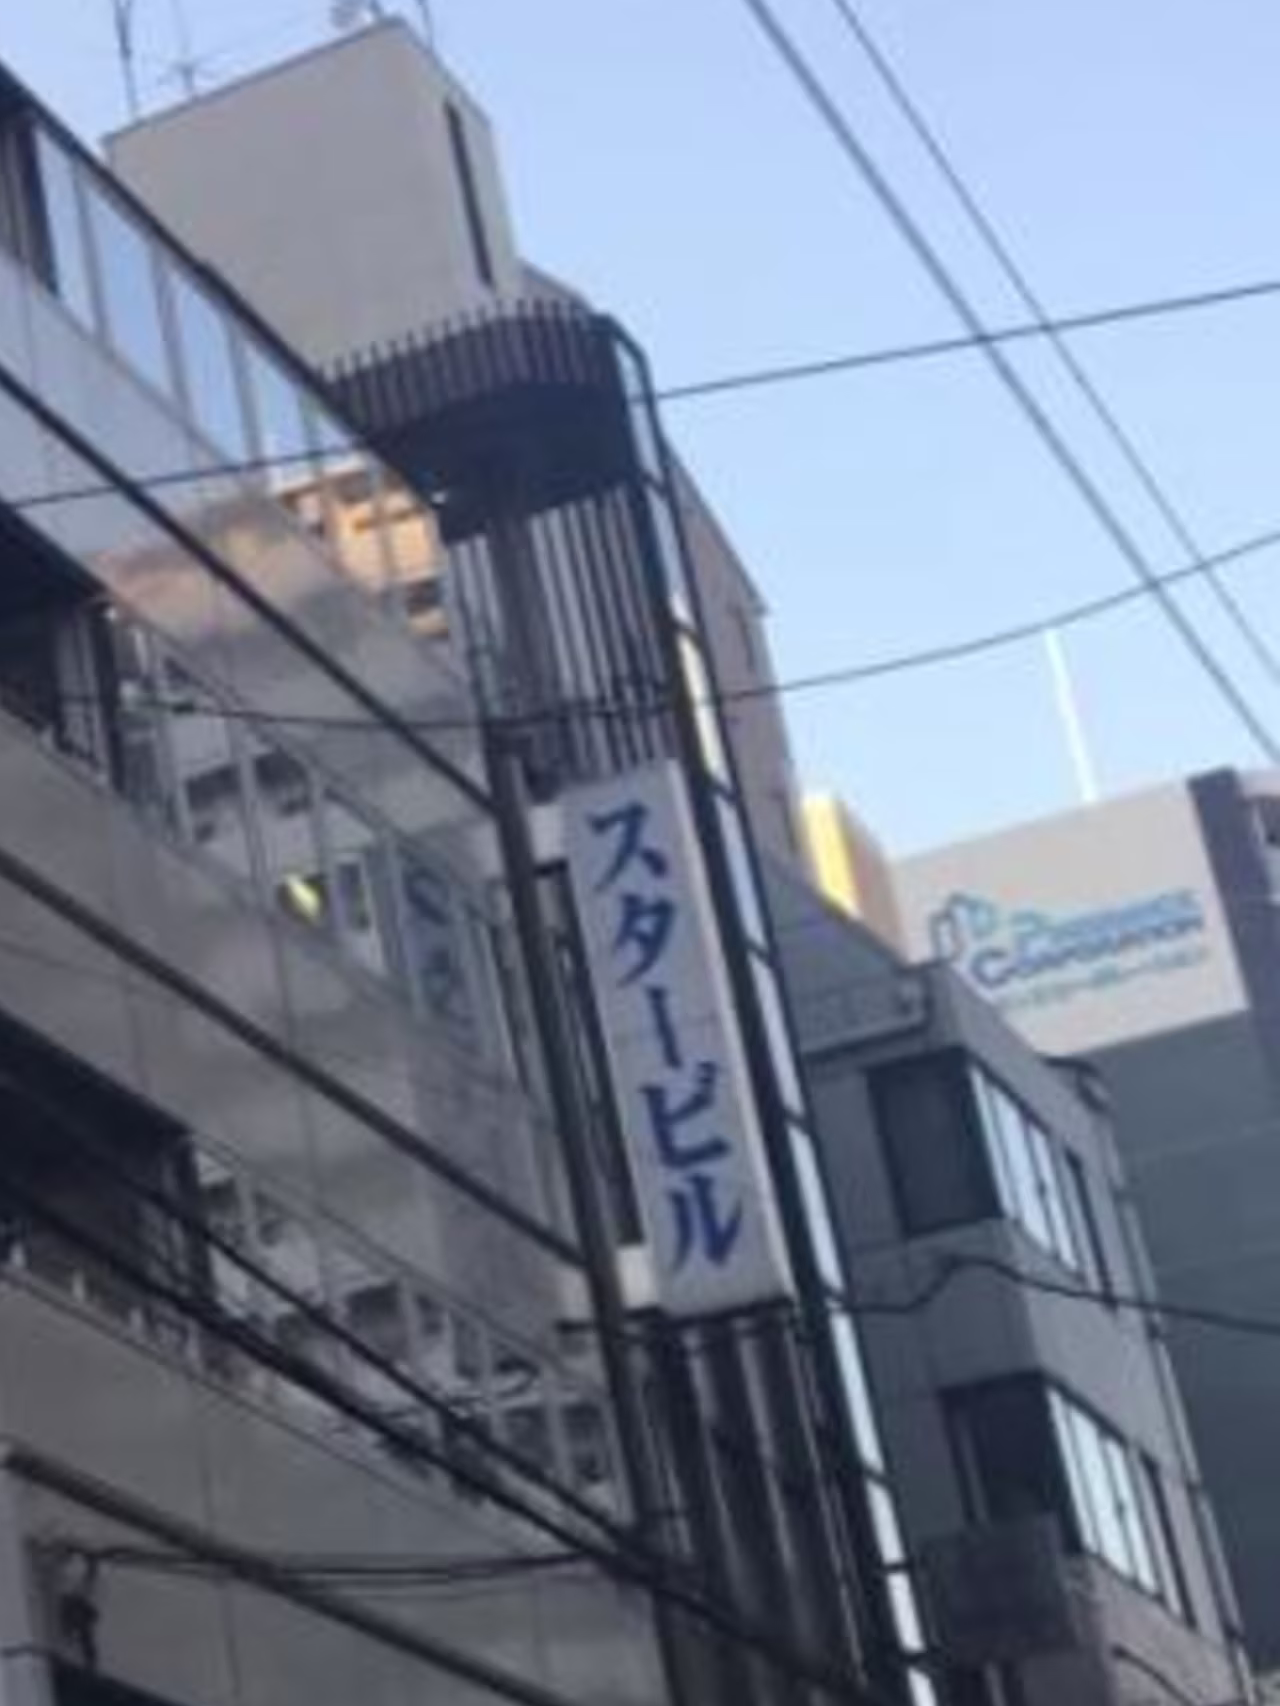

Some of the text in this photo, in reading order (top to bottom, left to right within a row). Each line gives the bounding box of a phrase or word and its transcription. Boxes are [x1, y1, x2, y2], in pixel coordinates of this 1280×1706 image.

[587, 802, 744, 1273] スタービル
